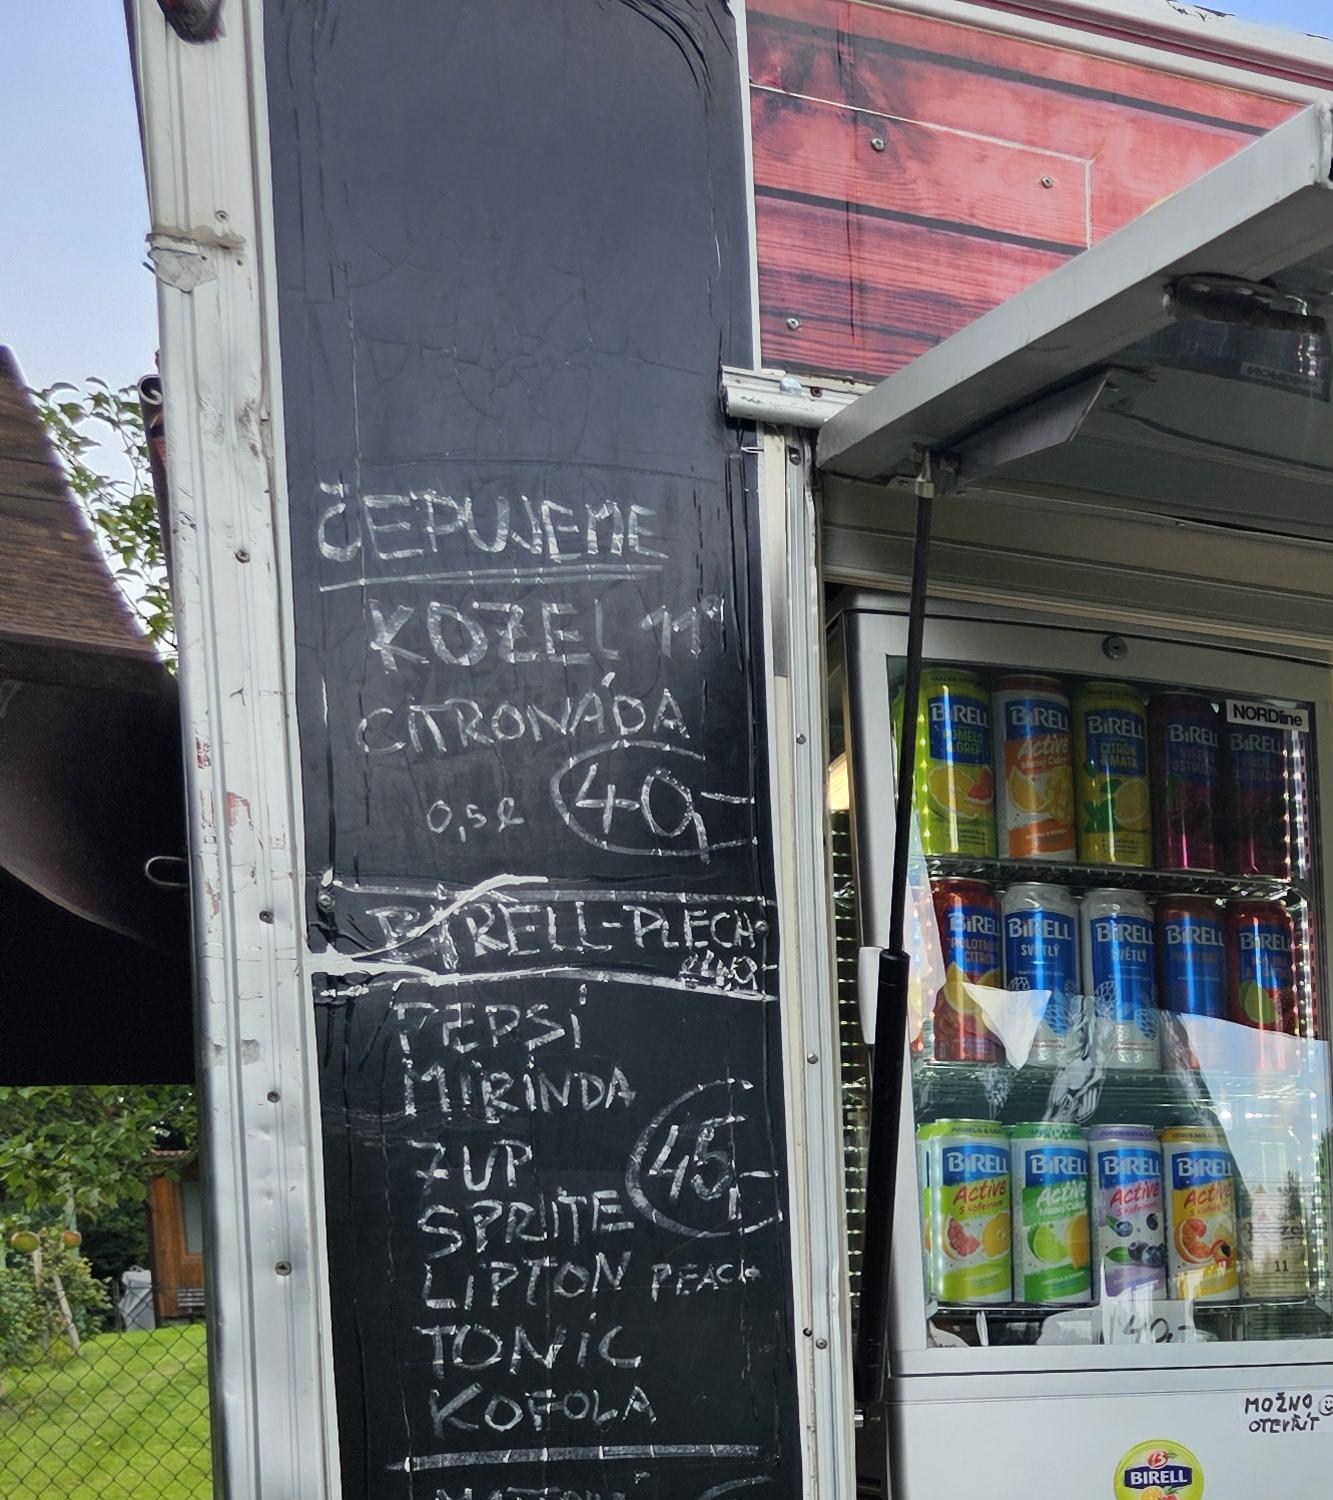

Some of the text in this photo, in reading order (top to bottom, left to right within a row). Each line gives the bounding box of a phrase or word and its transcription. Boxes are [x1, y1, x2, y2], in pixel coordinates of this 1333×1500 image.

[368, 598, 620, 673] KOZEL
[929, 702, 990, 728] BRELL
[1232, 702, 1304, 727] NORDline
[953, 1179, 1007, 1206] Active
[1036, 1179, 1087, 1207] Active
[1109, 1182, 1160, 1207] Active
[417, 1185, 635, 1260] SPRITE
[422, 1250, 632, 1310] LIPTON
[429, 1382, 656, 1439] KOFOLA
[1244, 1392, 1313, 1414] MOŽNO
[1130, 1470, 1188, 1485] BIRELL
